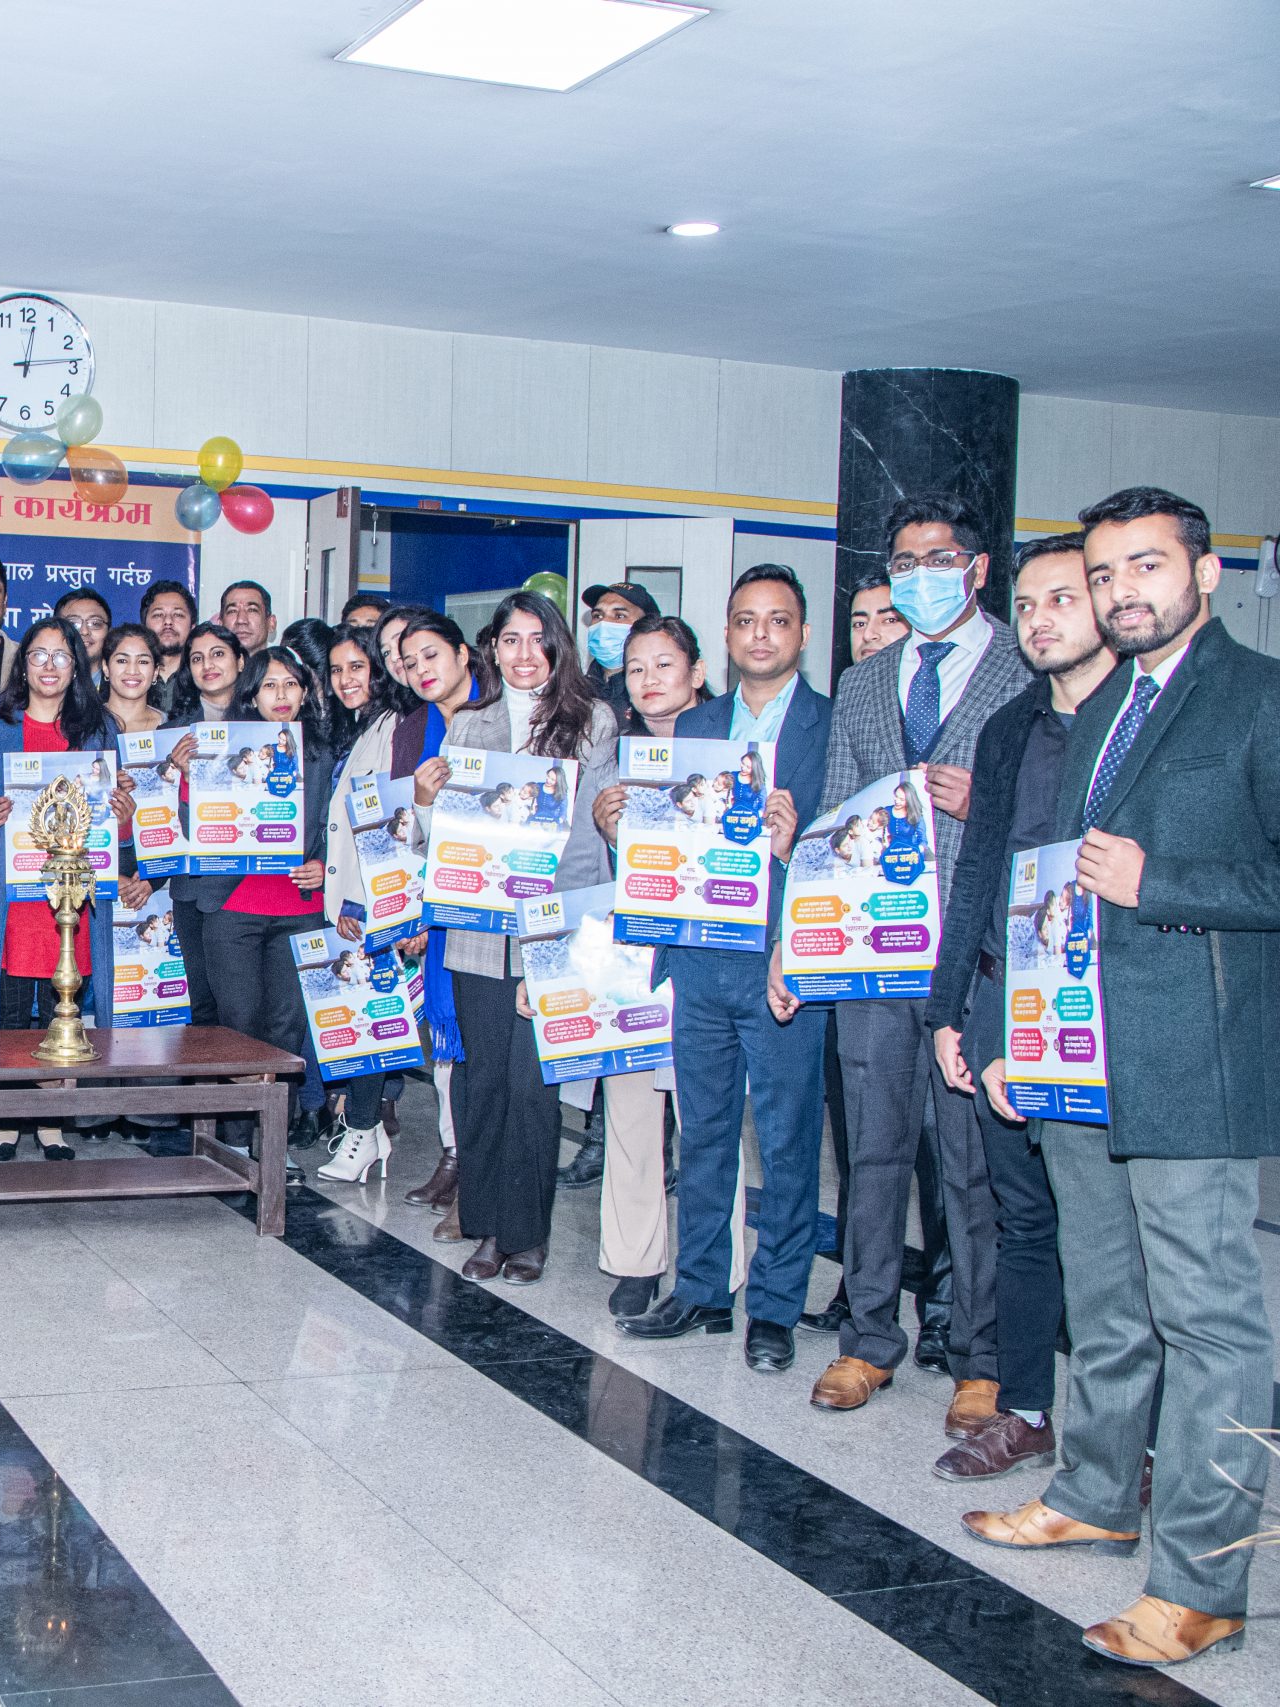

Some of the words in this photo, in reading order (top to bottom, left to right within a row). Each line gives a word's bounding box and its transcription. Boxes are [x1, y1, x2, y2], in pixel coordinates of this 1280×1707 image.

[20, 307, 36, 323] 12
[48, 317, 54, 332] 1
[63, 335, 73, 350] 2
[68, 360, 78, 375] 3
[60, 383, 71, 398] 4
[20, 405, 31, 420] 6
[44, 400, 54, 415] 5
[45, 563, 96, 589] प्रस्तुत
[107, 562, 152, 587] गर्दछ
[211, 729, 226, 740] LIC
[138, 738, 152, 749] LIC
[649, 749, 668, 762] LIC
[464, 758, 482, 771] LIC
[365, 795, 379, 809] LIC
[1024, 859, 1036, 875] LIC
[542, 902, 560, 916] LIC
[309, 938, 324, 950] LIC
